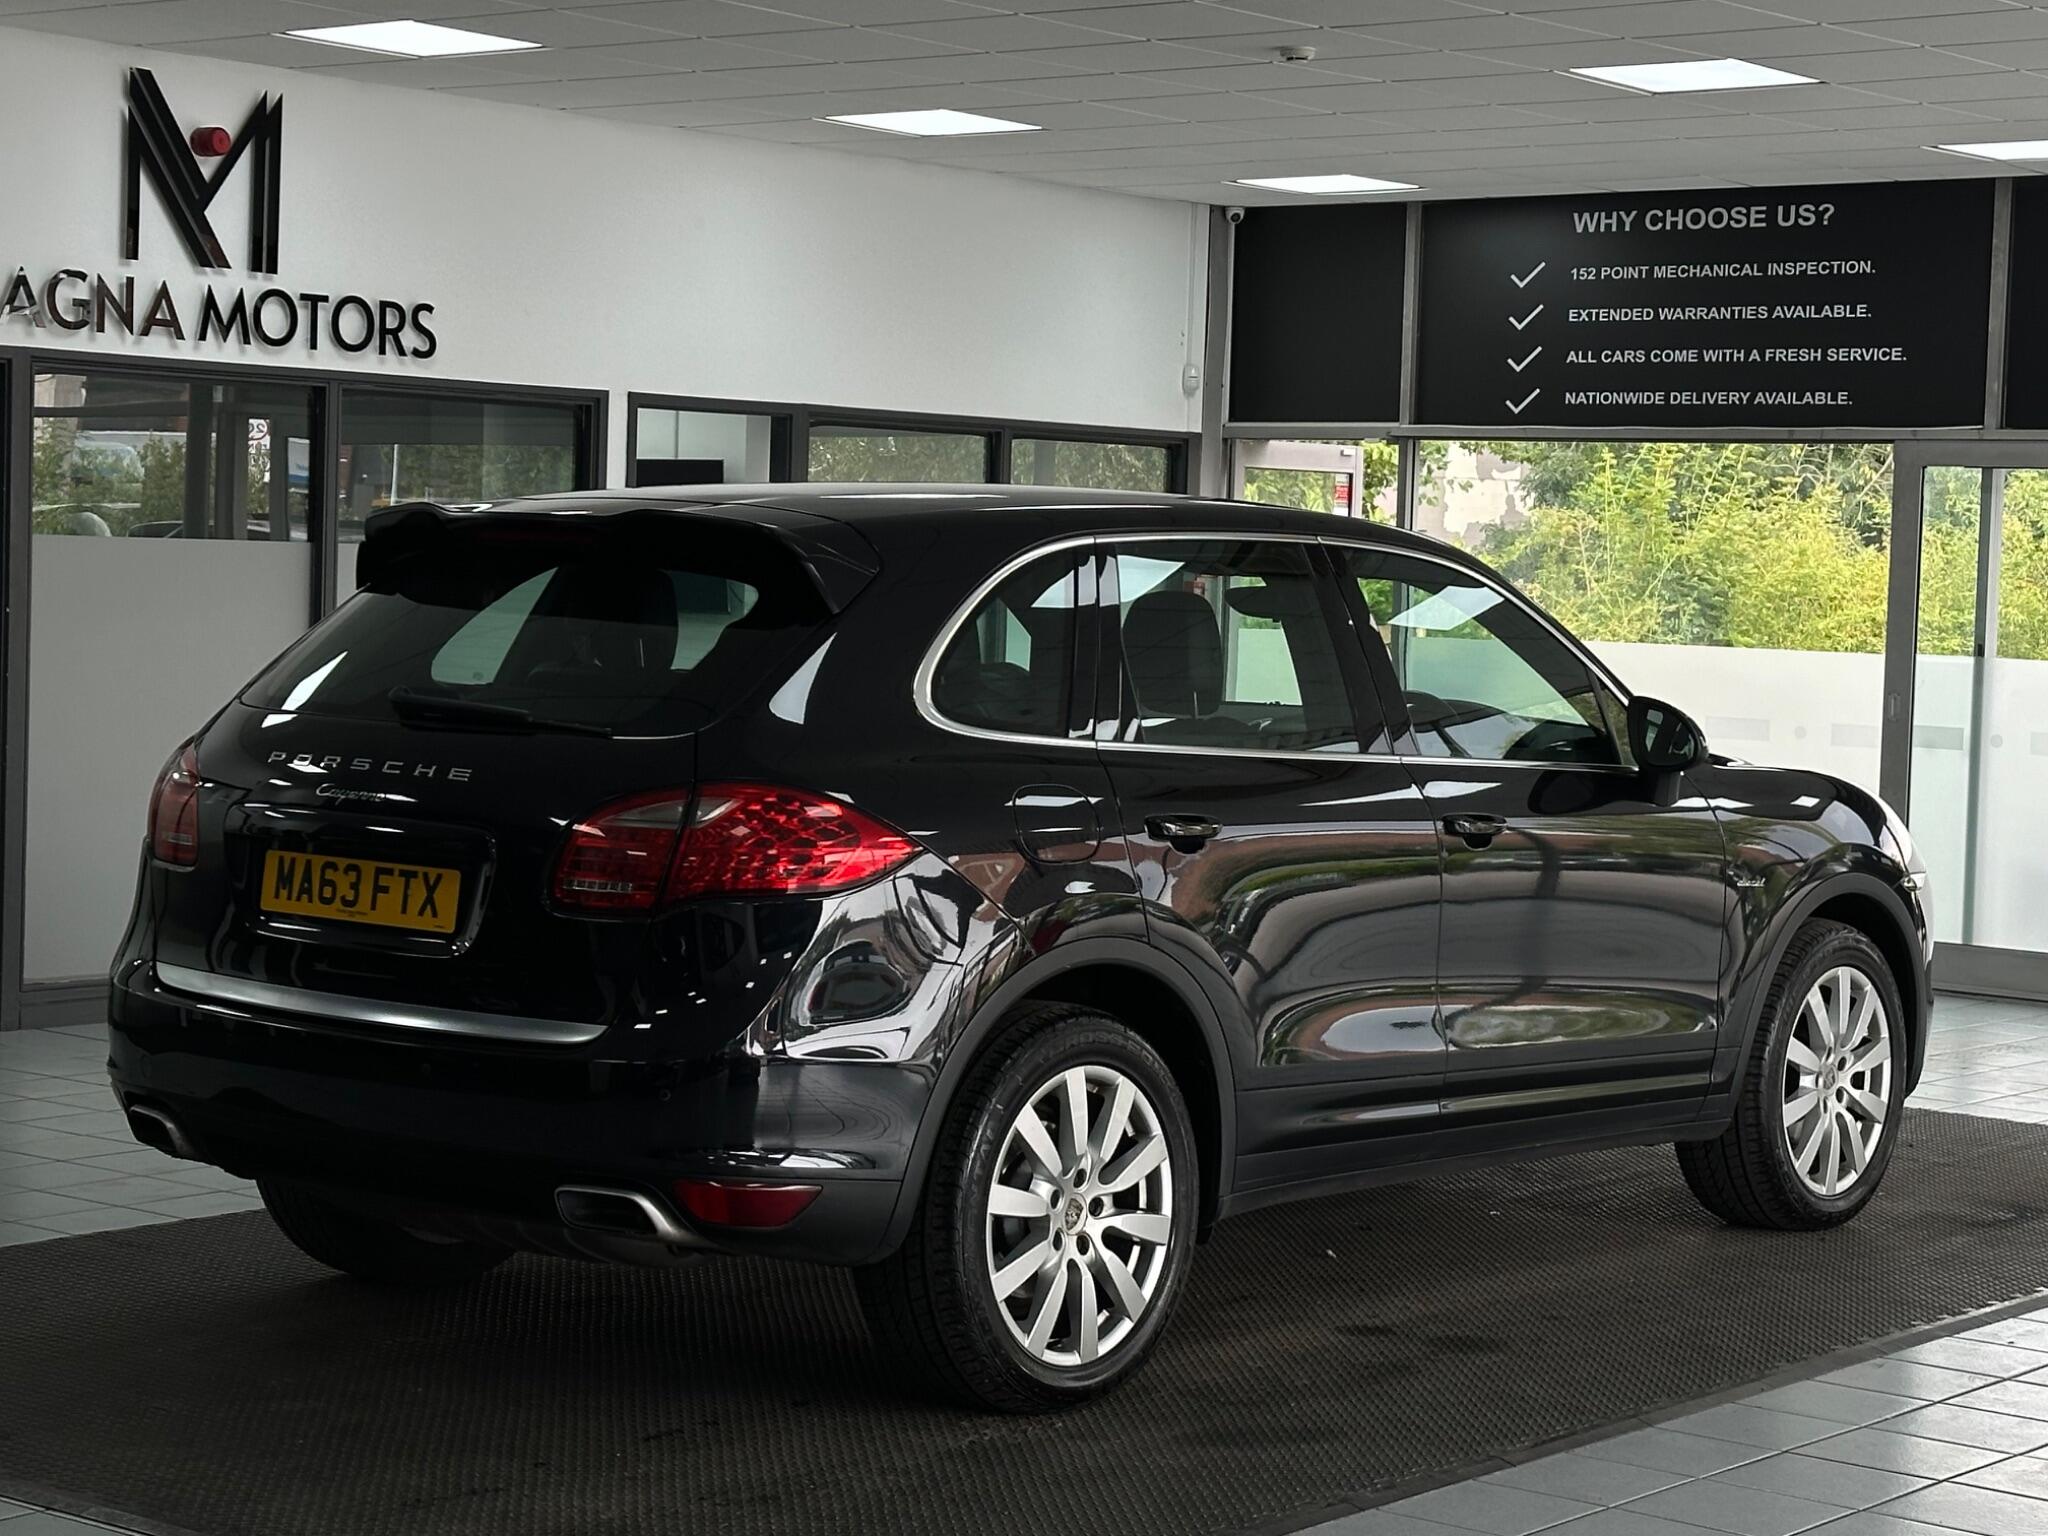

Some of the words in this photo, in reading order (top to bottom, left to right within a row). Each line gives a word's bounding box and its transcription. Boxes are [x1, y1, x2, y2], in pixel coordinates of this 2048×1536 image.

[1572, 209, 1638, 234] WHY
[1644, 205, 1768, 232] CHOOSE
[1776, 203, 1836, 228] US?
[1570, 267, 1597, 281] 152
[1601, 265, 1650, 280] POINT
[1653, 263, 1764, 279] MECHANICAL
[1767, 260, 1877, 276] INSPECTION.
[198, 284, 437, 360] MOTORS
[1568, 307, 1655, 322] EXTENDED
[1658, 305, 1769, 321] WARRANTIES
[1771, 304, 1873, 319] AVAILABLE.
[1566, 350, 1598, 364] ALL
[1600, 349, 1646, 364] CARS
[1650, 349, 1699, 363] COME
[1703, 349, 1745, 363] WITH
[1748, 348, 1761, 362] A
[1765, 348, 1822, 362] FRESH
[1826, 347, 1908, 361] SERVICE.
[1564, 391, 1666, 405] NATIONWIDE
[1669, 391, 1752, 405] DELIVERY
[1753, 391, 1853, 405] AVAILABLE.
[267, 751, 473, 782] PORSCHE
[273, 855, 362, 909] MA63
[370, 865, 443, 919] FTX
